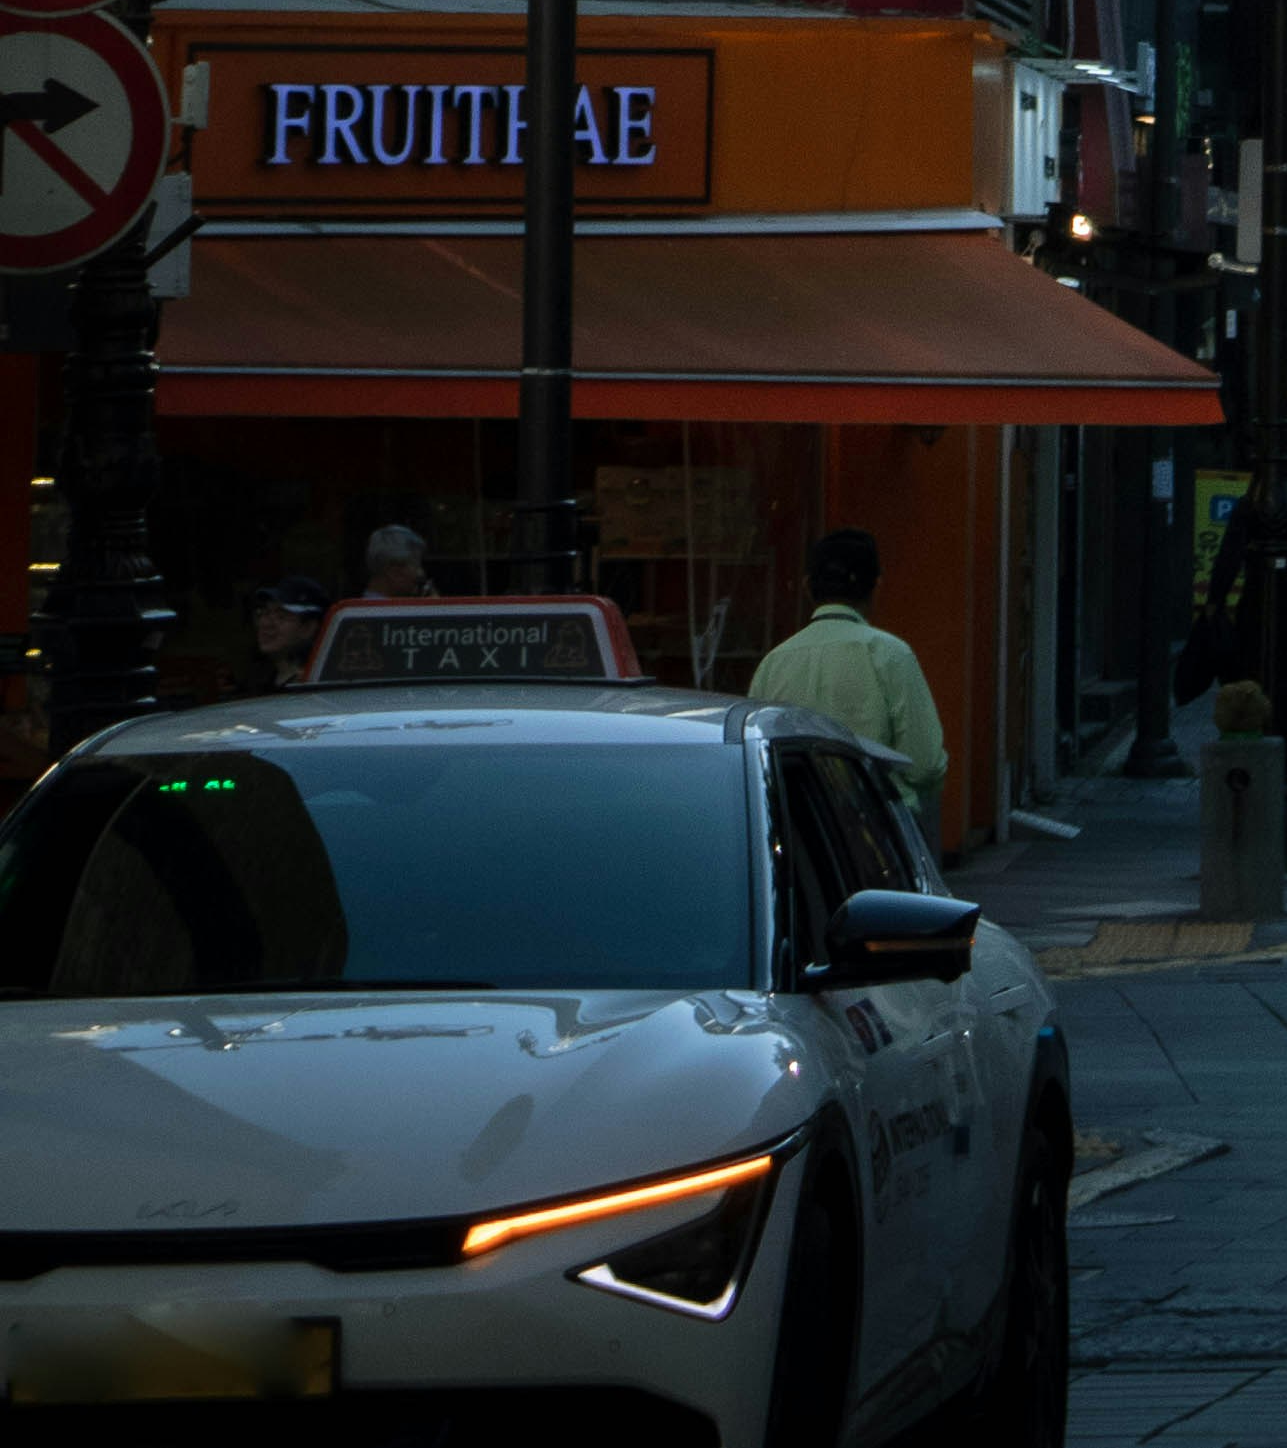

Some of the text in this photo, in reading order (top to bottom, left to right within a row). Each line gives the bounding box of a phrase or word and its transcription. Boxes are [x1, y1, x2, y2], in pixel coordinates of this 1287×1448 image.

[266, 82, 657, 167] FRUITAE
[382, 621, 549, 646] International
[403, 647, 528, 669] TAXI
